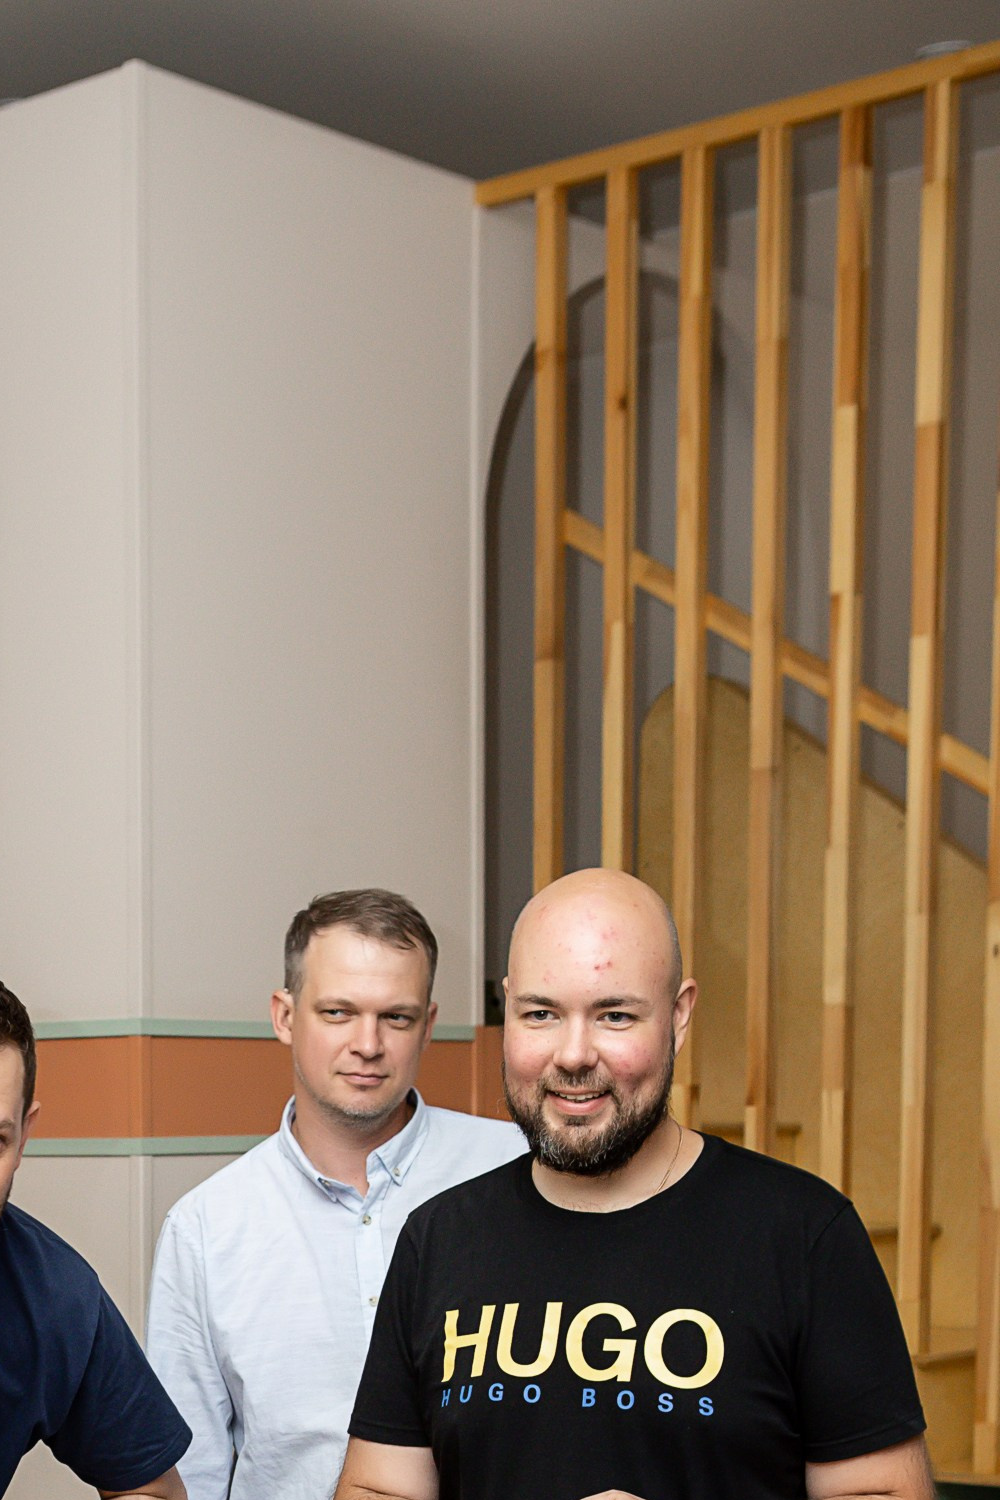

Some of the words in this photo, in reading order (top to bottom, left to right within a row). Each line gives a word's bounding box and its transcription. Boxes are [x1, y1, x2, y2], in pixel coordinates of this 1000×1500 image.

[441, 1301, 725, 1390] HUGO
[441, 1382, 542, 1408] HUGO
[581, 1387, 714, 1417] BOSS
